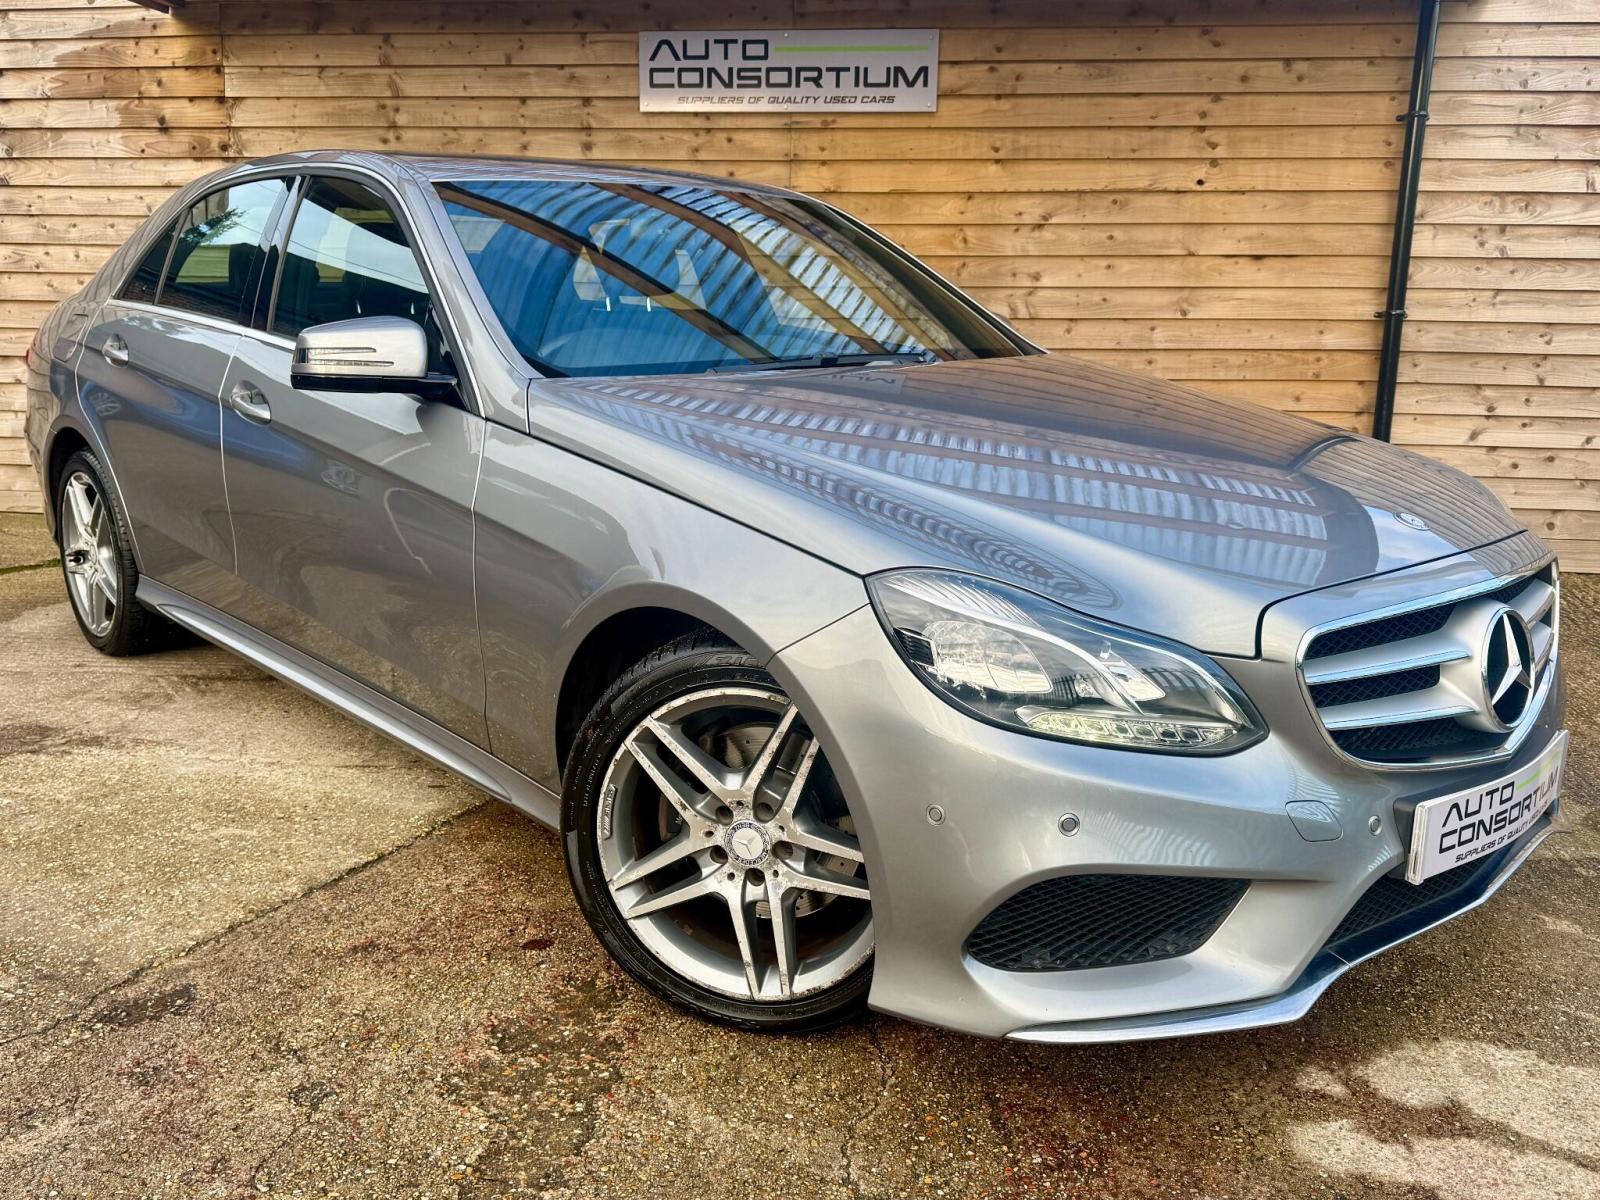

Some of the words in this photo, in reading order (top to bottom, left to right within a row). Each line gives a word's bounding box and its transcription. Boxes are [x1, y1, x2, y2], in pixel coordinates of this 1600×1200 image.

[649, 39, 769, 61] AUTO
[649, 66, 929, 88] CONSORTIUM
[677, 96, 745, 105] SUPPLIERS
[747, 96, 765, 105] OF
[767, 95, 820, 105] QUALITY
[823, 95, 858, 104] USED
[860, 95, 896, 104] CARS
[1439, 765, 1559, 855] CONSORTIUM
[1442, 781, 1515, 828] AUTO
[1455, 839, 1497, 863] SUPPLIERS
[1497, 833, 1507, 845] OF
